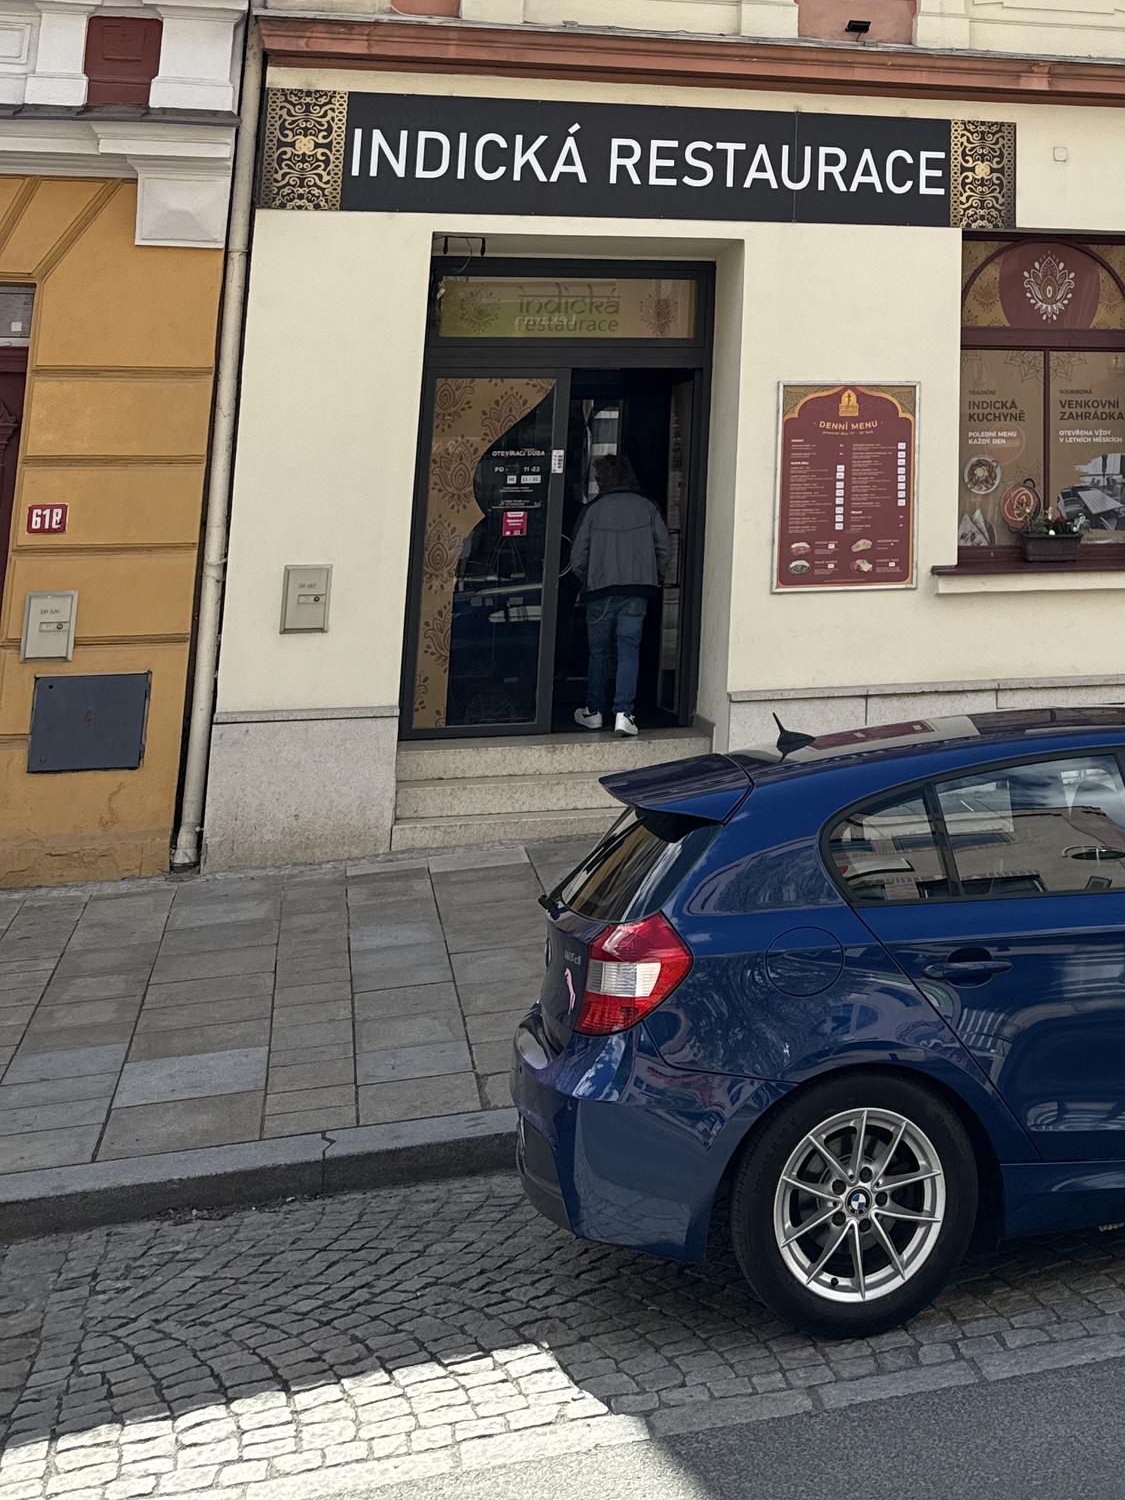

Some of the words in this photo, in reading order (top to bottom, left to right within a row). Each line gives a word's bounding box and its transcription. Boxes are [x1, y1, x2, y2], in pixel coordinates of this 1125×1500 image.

[351, 123, 588, 184] INDICKÁ
[608, 138, 946, 195] RESTAURACE
[518, 283, 620, 315] indická
[518, 316, 619, 332] restaurace
[968, 398, 1018, 411] INDICKÁ
[1059, 397, 1120, 409] VENKOVNÍ
[968, 410, 1026, 422] KUCHYNĚ
[1059, 409, 1124, 421] ZAHRÁDKA
[819, 420, 848, 430] DENNÍ
[851, 420, 878, 430] MENU
[968, 430, 997, 438] POLEDNÍ
[968, 437, 991, 445] KAŽDÝ
[32, 508, 62, 529] 618
